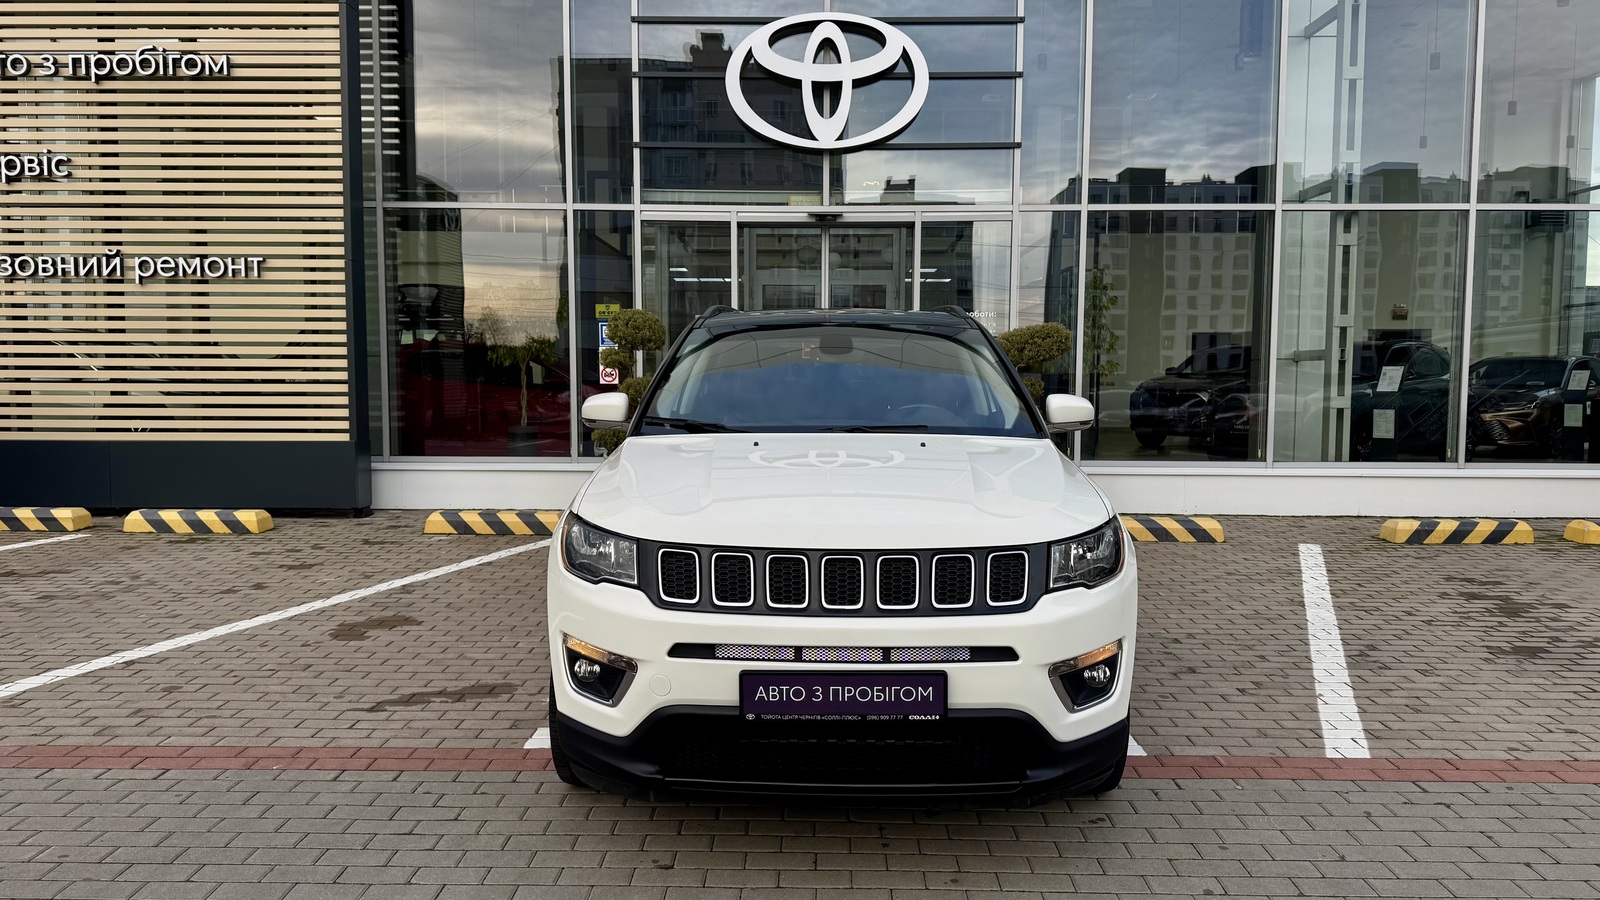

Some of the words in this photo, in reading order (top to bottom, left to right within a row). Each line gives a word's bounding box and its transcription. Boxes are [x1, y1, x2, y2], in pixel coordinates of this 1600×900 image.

[40, 54, 57, 76] з
[68, 45, 230, 83] пробігом
[0, 148, 69, 184] рвіс
[135, 255, 264, 285] ремонт
[754, 686, 806, 702] АВТО
[811, 686, 823, 702] З
[829, 686, 933, 702] ПРОБІГОМ
